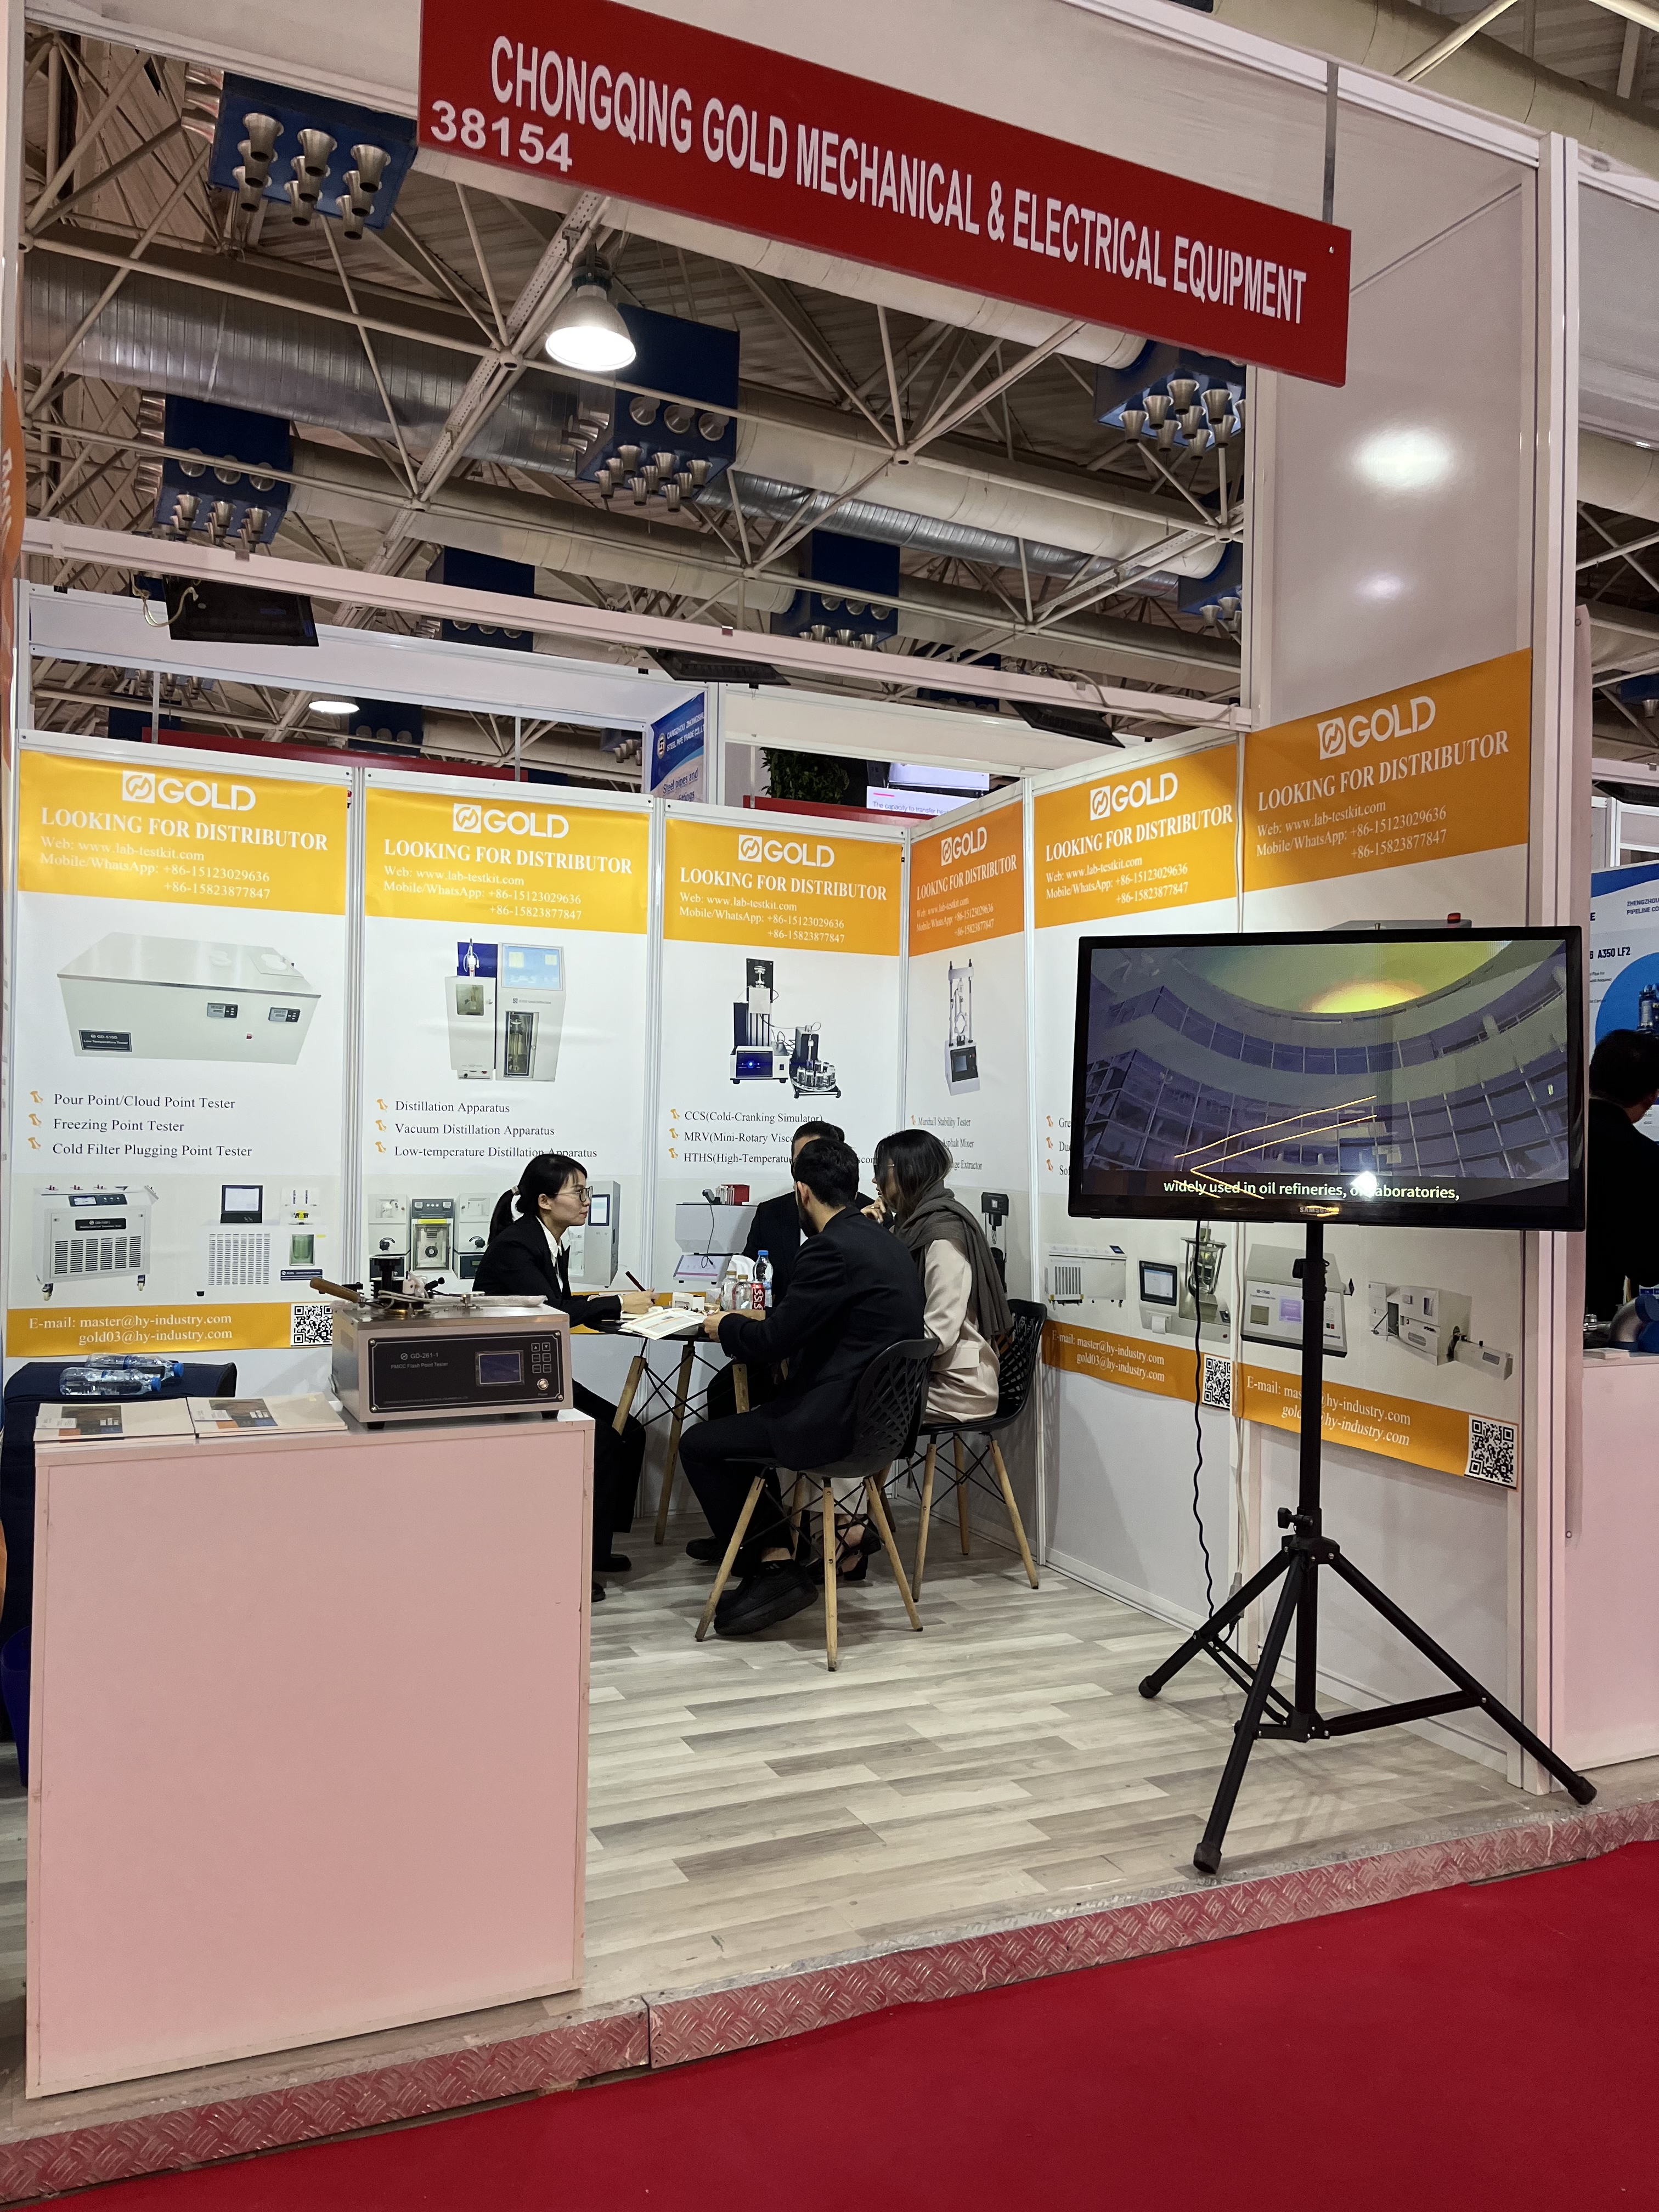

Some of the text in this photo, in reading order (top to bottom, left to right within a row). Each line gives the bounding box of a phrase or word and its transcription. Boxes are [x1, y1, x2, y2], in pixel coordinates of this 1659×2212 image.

[430, 102, 573, 173] 38154
[490, 36, 1307, 326] CHONGQING GOLD MECHANICAL & ELECTRICAL EQUIPMENT
[1348, 696, 1436, 748] GOLD
[663, 768, 698, 794] Steel pipes and
[1258, 731, 1509, 811] LOOKING FOR DISTRIBUTOR
[158, 778, 256, 811] GOLD
[1111, 772, 1178, 812] GOLD
[41, 807, 328, 851] LOOKING FOR DISTRIBUTOR
[484, 809, 569, 838] GOLD
[1257, 801, 1386, 837] Web: www.lab-testkit.com
[1046, 804, 1233, 862] LOOKING FOR DISTRIBUTOR
[1256, 806, 1446, 856] Mobile/WhatsApp: +86-15123029636
[41, 836, 205, 861] Web: www.lab-testkit.com
[764, 840, 835, 867] GOLD
[953, 827, 987, 859] GOLD
[1351, 829, 1447, 860] +86-15823877847
[40, 853, 270, 882] Mobile/WhatsApp: +86-15123029636
[385, 839, 632, 874] LOOKING FOR DISTRIBUTOR
[385, 866, 524, 886] Web: www.lab-testkit.com
[917, 854, 1017, 900] LOOKING FOR DISTRIBUTOR
[1046, 857, 1142, 883] Web: www.lab-testkit.com
[165, 881, 270, 899] +86-15823877847
[680, 867, 887, 900] LOOKING FOR DISTRIBUTOR
[1046, 863, 1188, 900] Mobile/WhatsApp: +86-15123029636
[384, 882, 581, 904] Mobile/WhatsApp: +86-15123029636
[680, 892, 797, 911] Web: www.lab-testkit.com
[1116, 882, 1188, 904] +86-15823877847
[489, 905, 582, 920] +86-15823877847
[680, 906, 844, 929] Mobile/WhatsApp: +86-15123029636
[768, 929, 845, 943] +86-15823877847
[1598, 948, 1615, 958] A350
[1617, 947, 1630, 956] LF2
[54, 1094, 235, 1109] Pour Point/Cloud Point Tester
[395, 1101, 510, 1114] Distillation Apparatus
[53, 1119, 184, 1132] Freezing Point Tester
[685, 1111, 822, 1124] CCS(Cold-Cranking Simulator)
[918, 1117, 971, 1128] Marshall Stability Tester
[1059, 1118, 1071, 1128] Gre
[395, 1124, 555, 1137] Vacuum Distillation Apparatus
[684, 1132, 793, 1144] MRV(Mini-Rotary Visco
[53, 1144, 252, 1158] Cold Filter Plugging Point Tester
[394, 1146, 597, 1158] Low-temperature Distillation Apparatus
[960, 1139, 974, 1148] Mixer
[684, 1153, 792, 1165] HTHS(High-Temperatu
[961, 1160, 983, 1170] Extractor
[1164, 1181, 1206, 1195] widely
[1209, 1181, 1240, 1193] used
[1244, 1182, 1256, 1193] in
[1259, 1182, 1276, 1194] oil
[1279, 1182, 1347, 1198] refineries,
[1374, 1184, 1459, 1201] aboratories,
[29, 1313, 232, 1329] E-mail: master@hy-industry.com
[79, 1329, 233, 1346] gold03@hy-industry.com
[1052, 1330, 1165, 1365] E-mail: master@hy-industry.com
[1077, 1352, 1165, 1382] gold03@hy-industry.com
[1247, 1376, 1280, 1395] E-mail:
